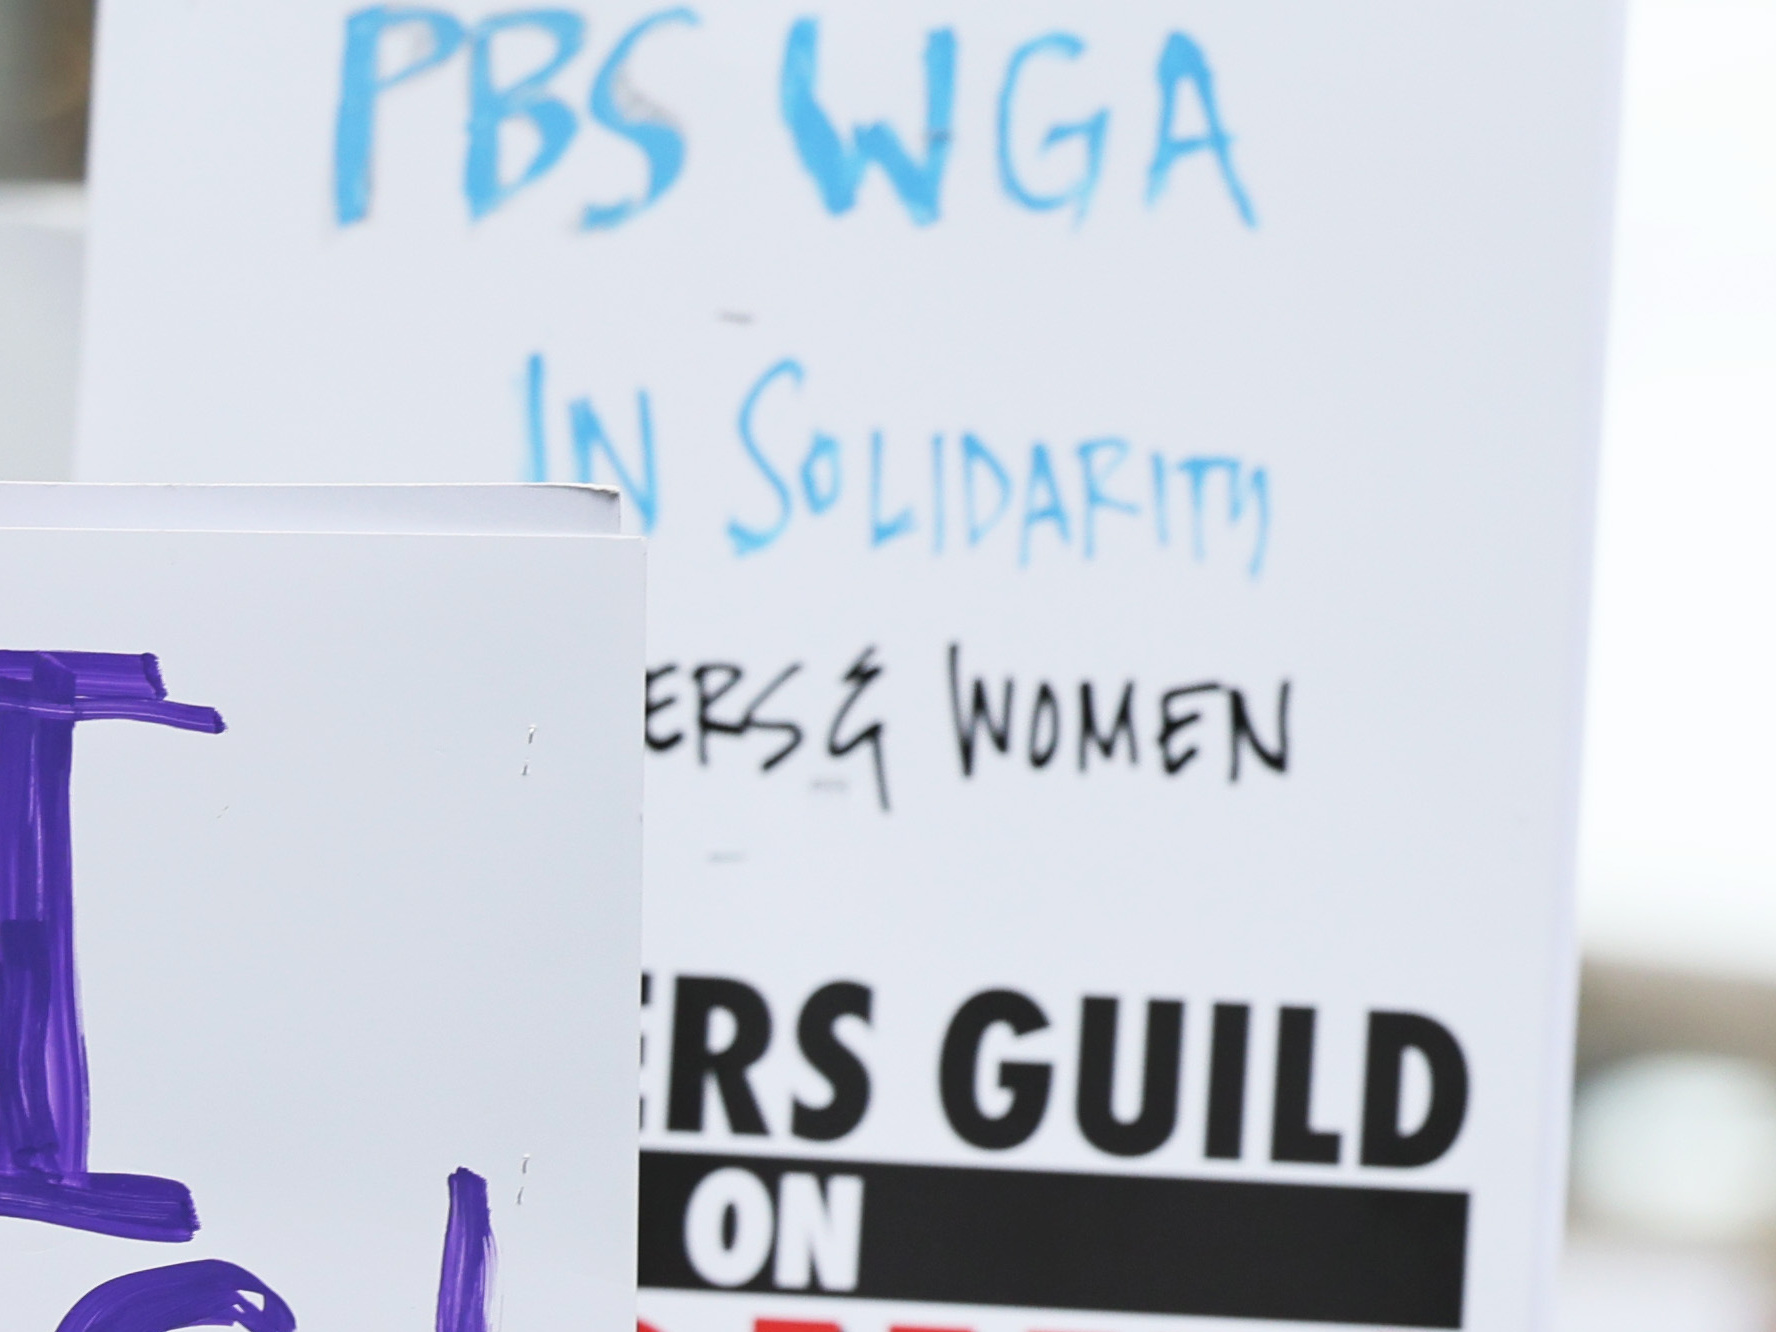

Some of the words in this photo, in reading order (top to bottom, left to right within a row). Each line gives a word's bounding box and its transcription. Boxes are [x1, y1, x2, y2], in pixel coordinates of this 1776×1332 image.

[330, 4, 704, 231] PBS
[777, 15, 1258, 229] WGA
[948, 643, 1292, 783] WOMEN
[937, 986, 1471, 1170] GUILD
[684, 1166, 864, 1292] ON
